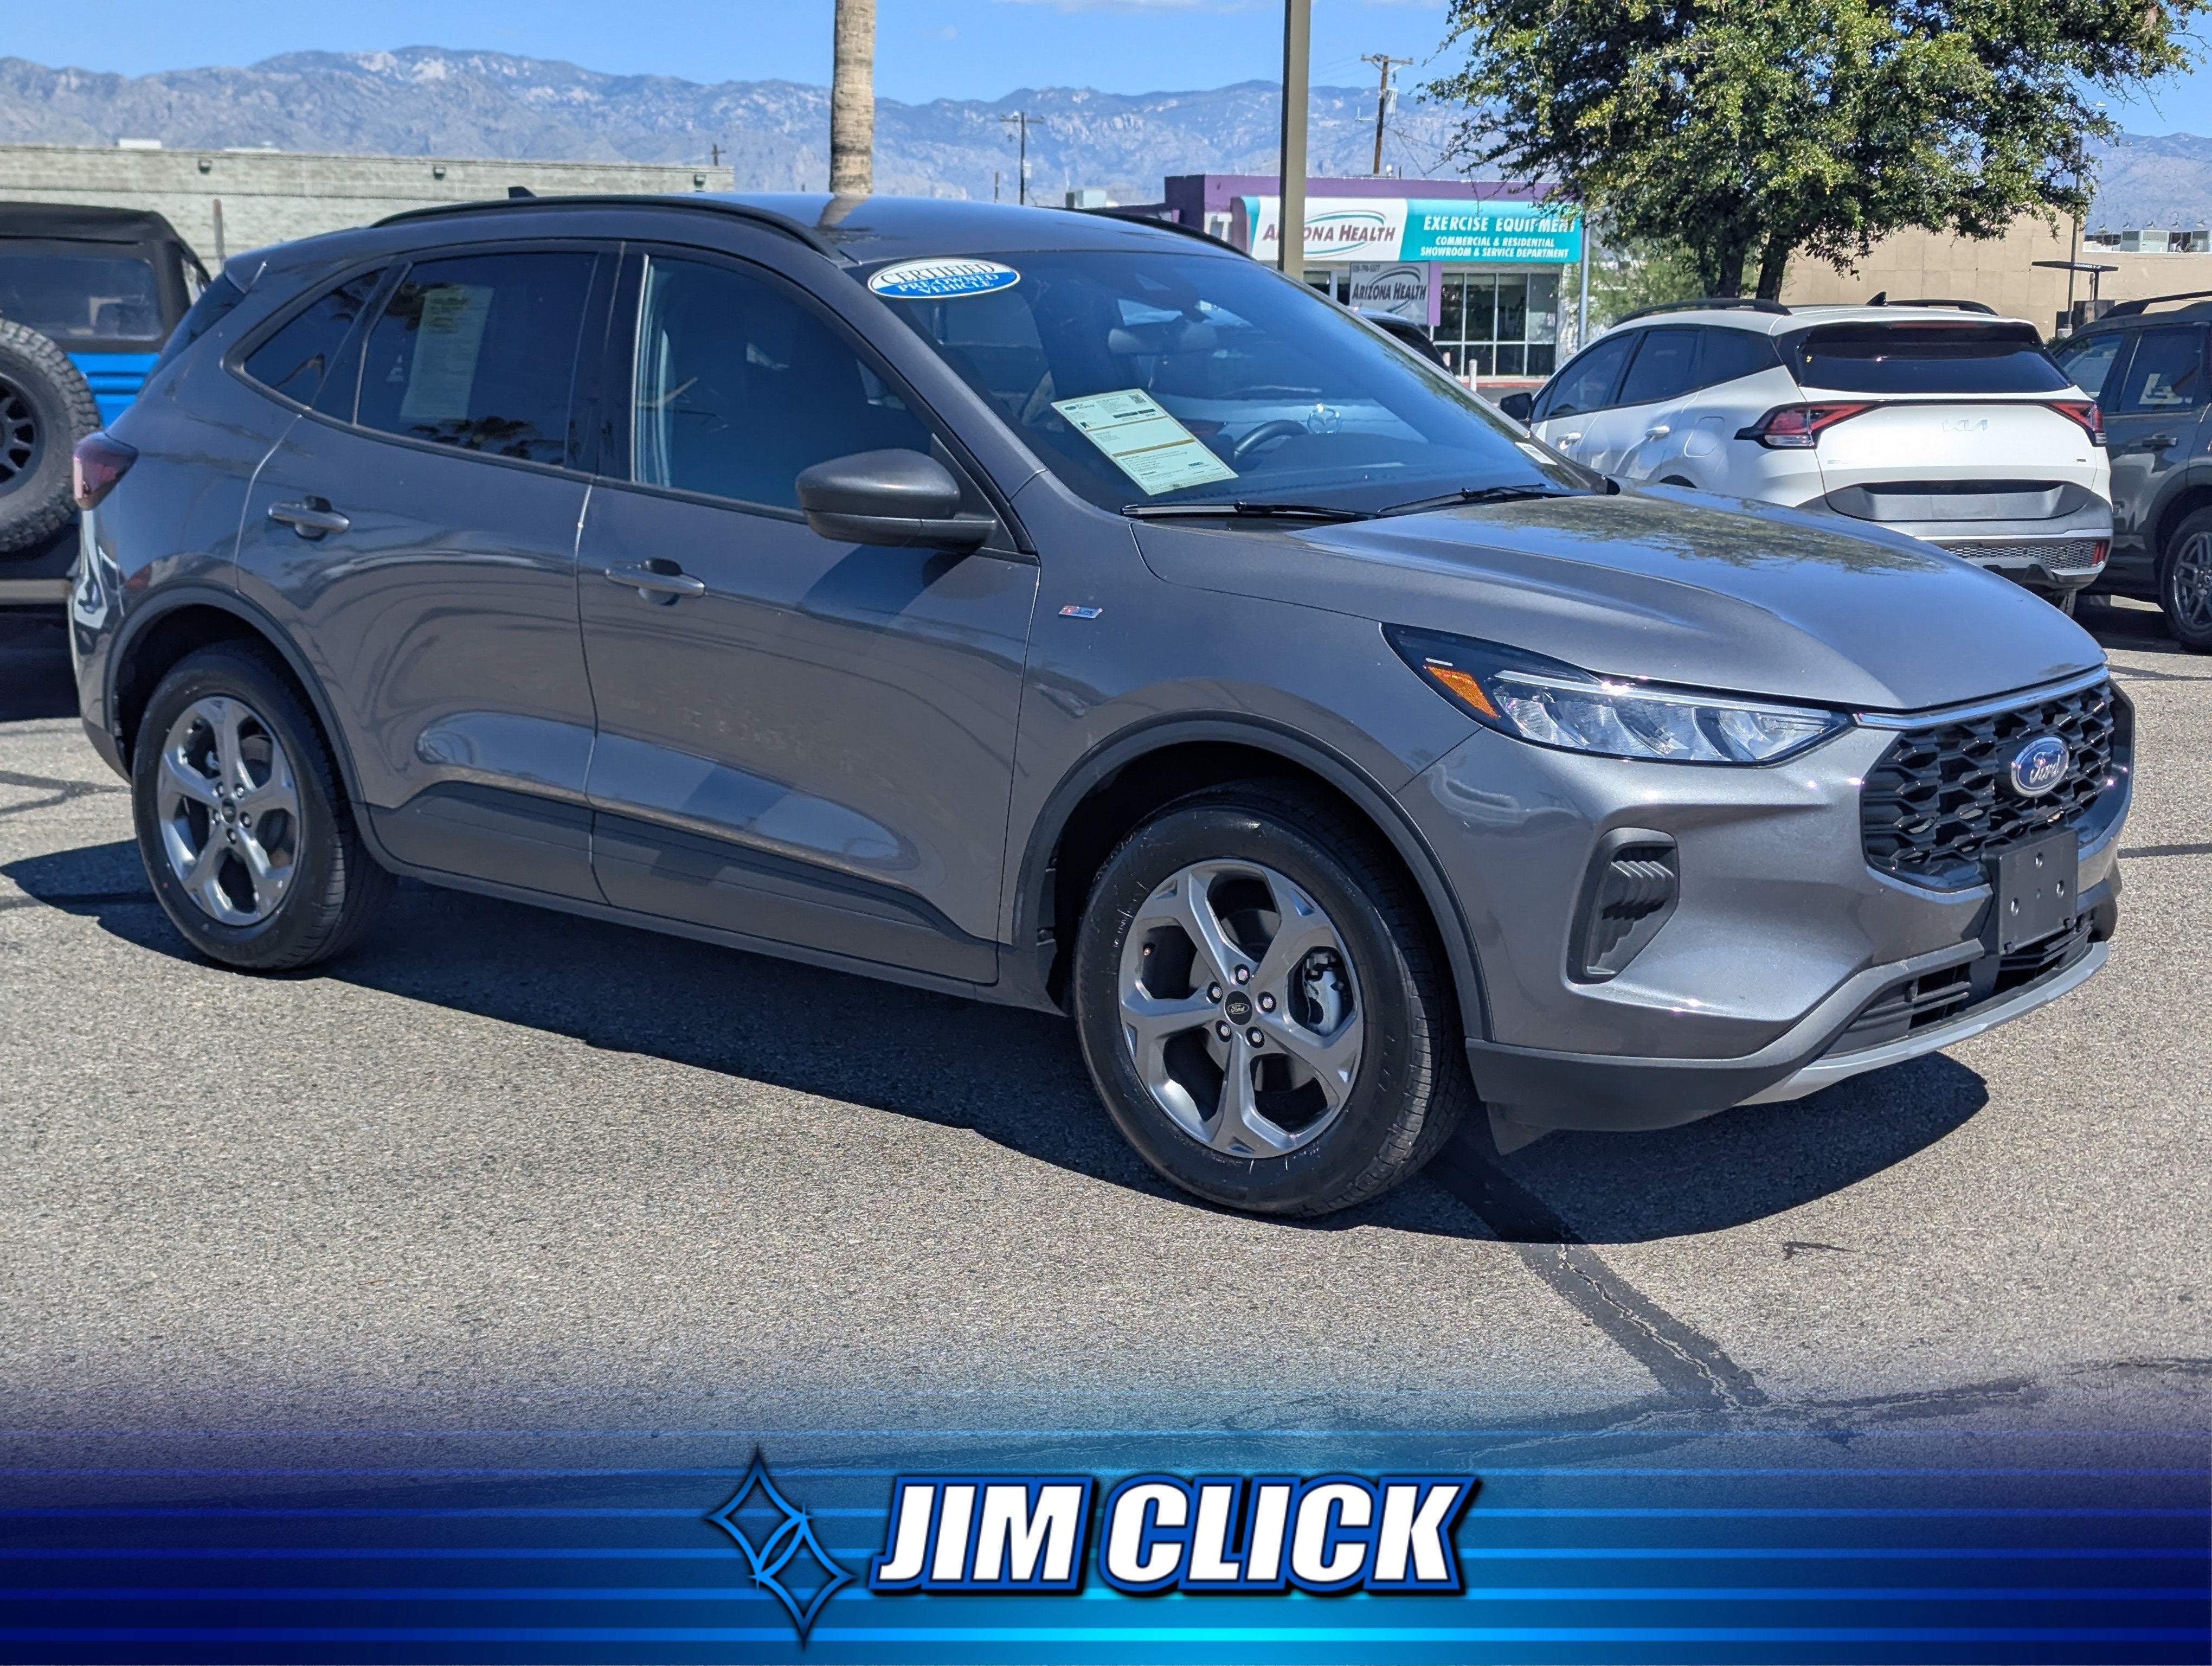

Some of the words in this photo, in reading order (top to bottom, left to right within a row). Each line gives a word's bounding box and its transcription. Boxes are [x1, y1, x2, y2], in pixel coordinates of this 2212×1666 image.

[1423, 215, 1489, 232] EXERCISE
[1338, 225, 1396, 241] HEALTH
[1435, 236, 1491, 246] COMMERCIAL
[1493, 238, 1500, 246] &
[1502, 238, 1555, 247] RESIDENTIAL
[1420, 246, 1471, 257] SHOWROOM
[1473, 247, 1480, 257] &
[1482, 247, 1514, 258] SERVICE
[1516, 248, 1569, 258] DEPARTMENT
[880, 264, 995, 284] CERTIFIED
[918, 280, 994, 294] VEHICLE
[1352, 283, 1391, 300] ARIZONA
[1393, 283, 1427, 300] HEALTH
[2029, 751, 2060, 784] Ford
